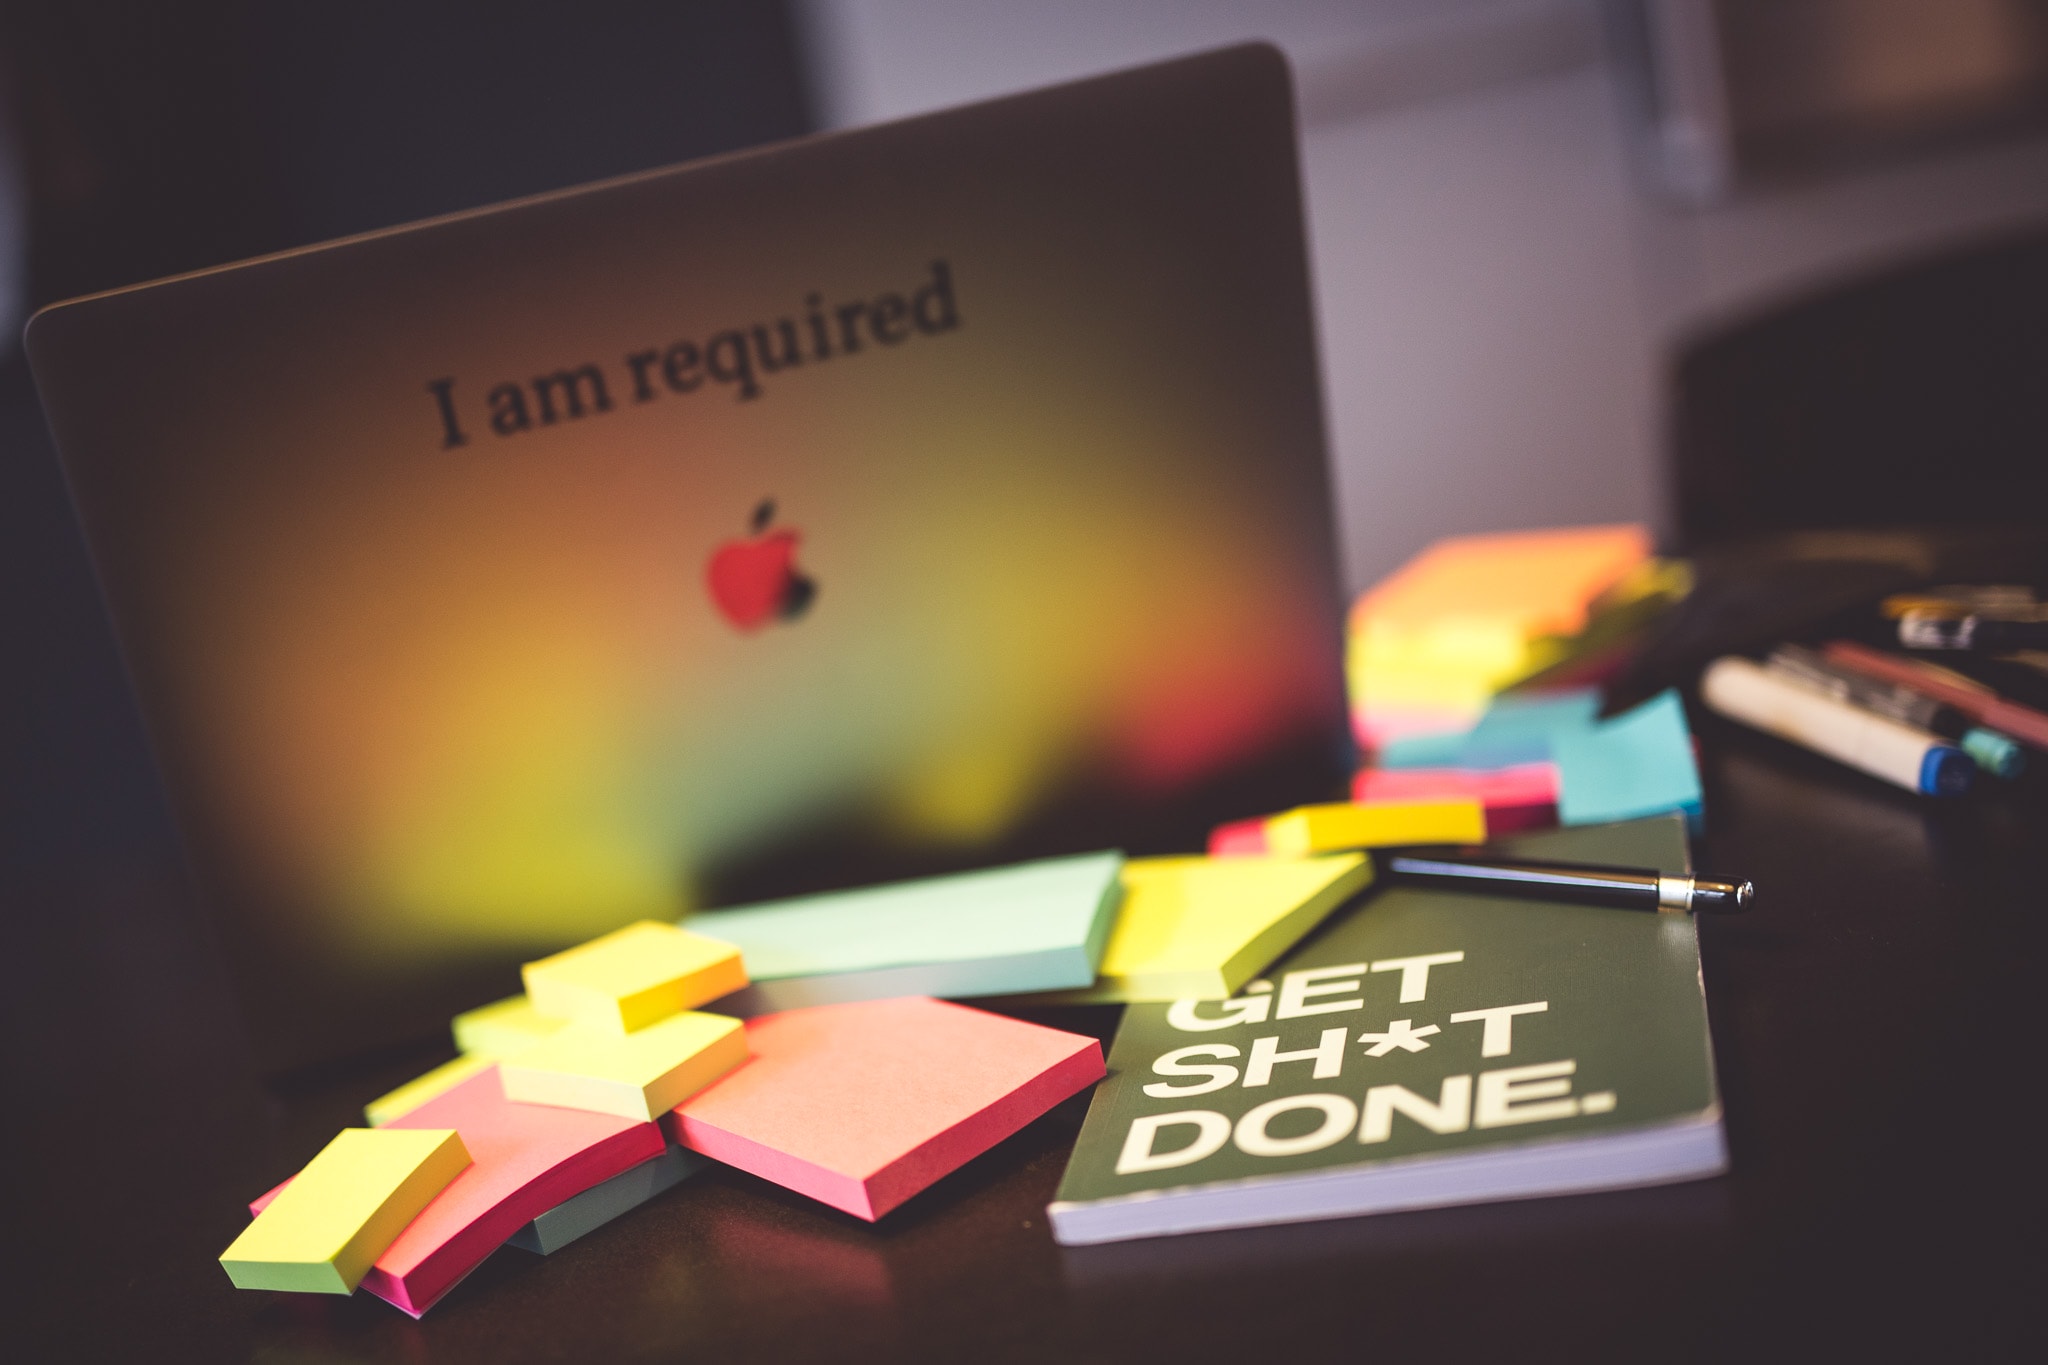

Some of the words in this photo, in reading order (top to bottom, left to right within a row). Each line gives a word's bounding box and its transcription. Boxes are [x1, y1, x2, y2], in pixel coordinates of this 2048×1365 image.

[425, 374, 471, 451] I
[485, 361, 615, 438] am
[625, 258, 962, 402] required
[1115, 1059, 1618, 1175] DONE.
